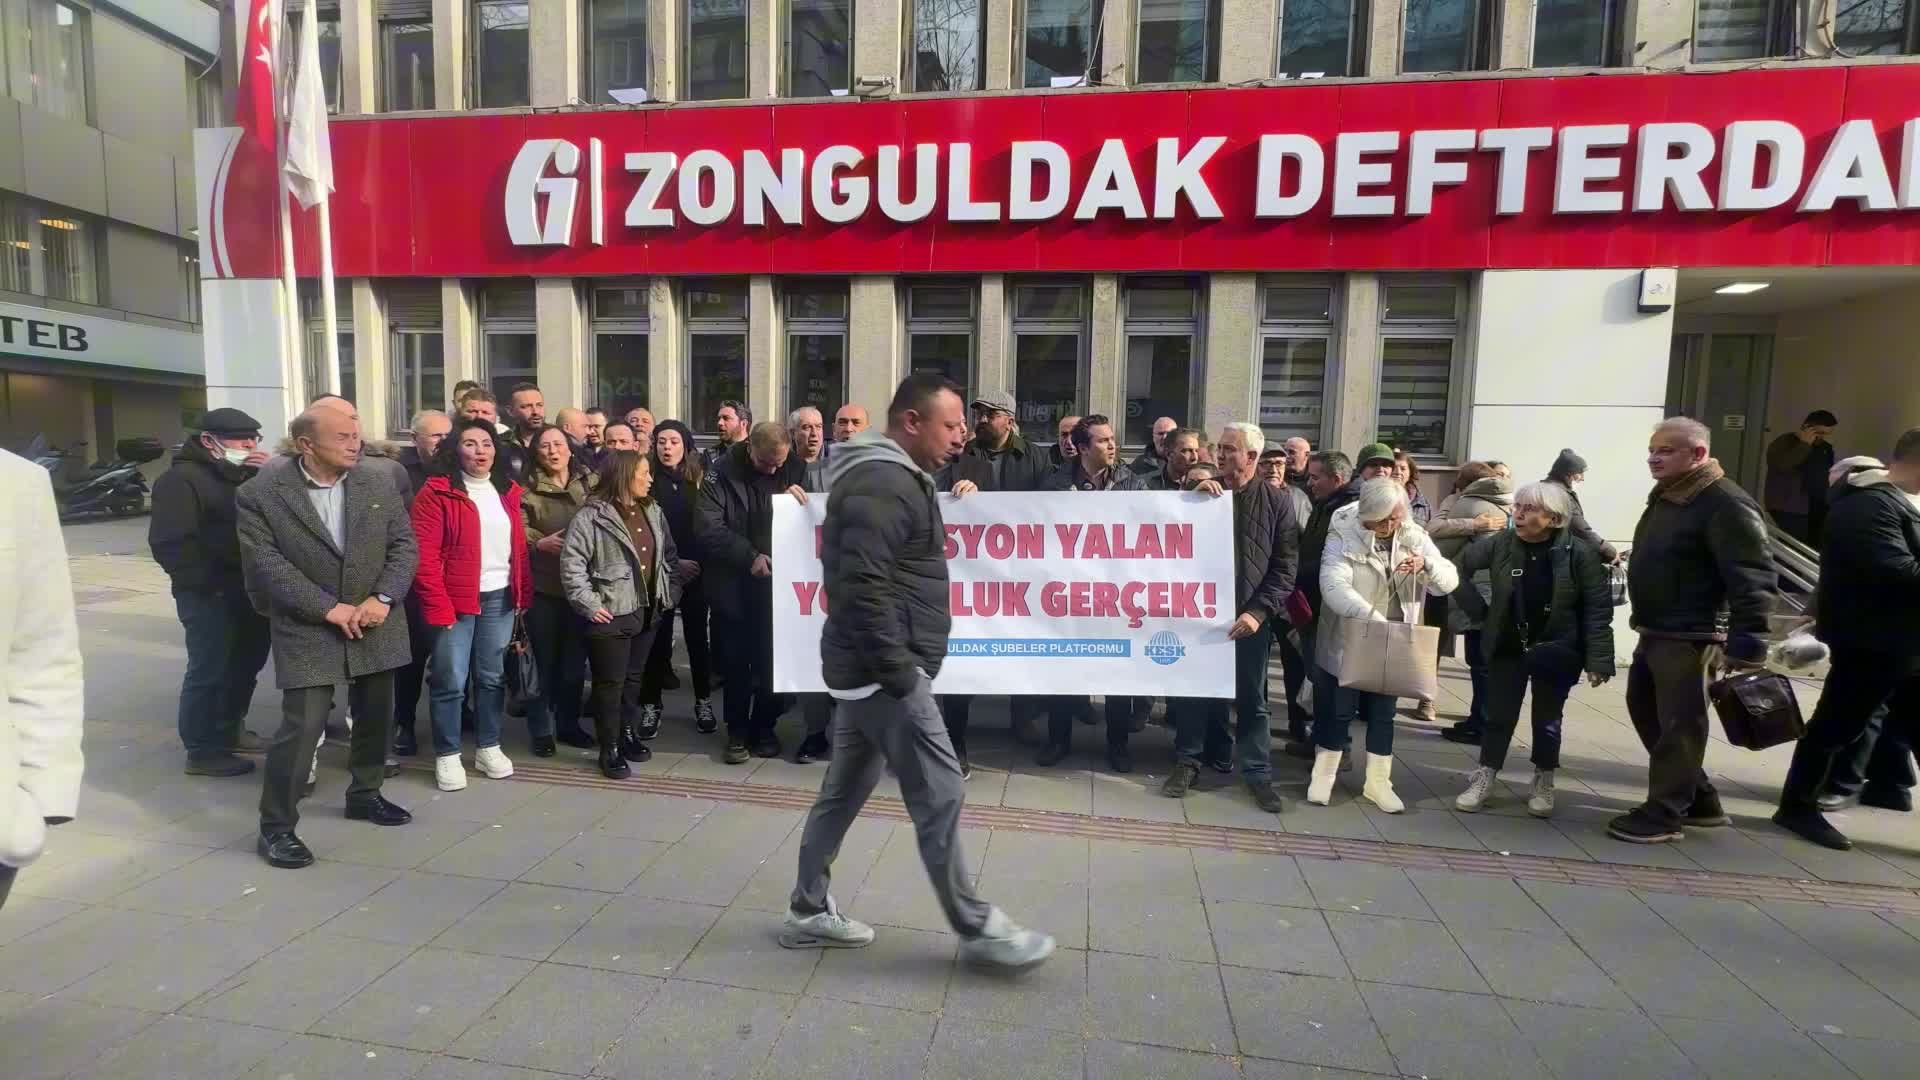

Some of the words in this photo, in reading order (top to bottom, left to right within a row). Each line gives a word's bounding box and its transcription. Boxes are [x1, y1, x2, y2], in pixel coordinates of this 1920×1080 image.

[624, 136, 1228, 227] ZONGULDAK
[1255, 117, 1920, 217] DEFTERDA
[0, 316, 89, 352] TEB
[1055, 523, 1193, 560] YALAN
[1040, 581, 1217, 628] GERÇEK!
[947, 643, 988, 654] ULDAK
[991, 643, 1047, 656] ŞUBELER
[1049, 643, 1124, 654] PLATFORMU
[1144, 645, 1186, 657] KESK
